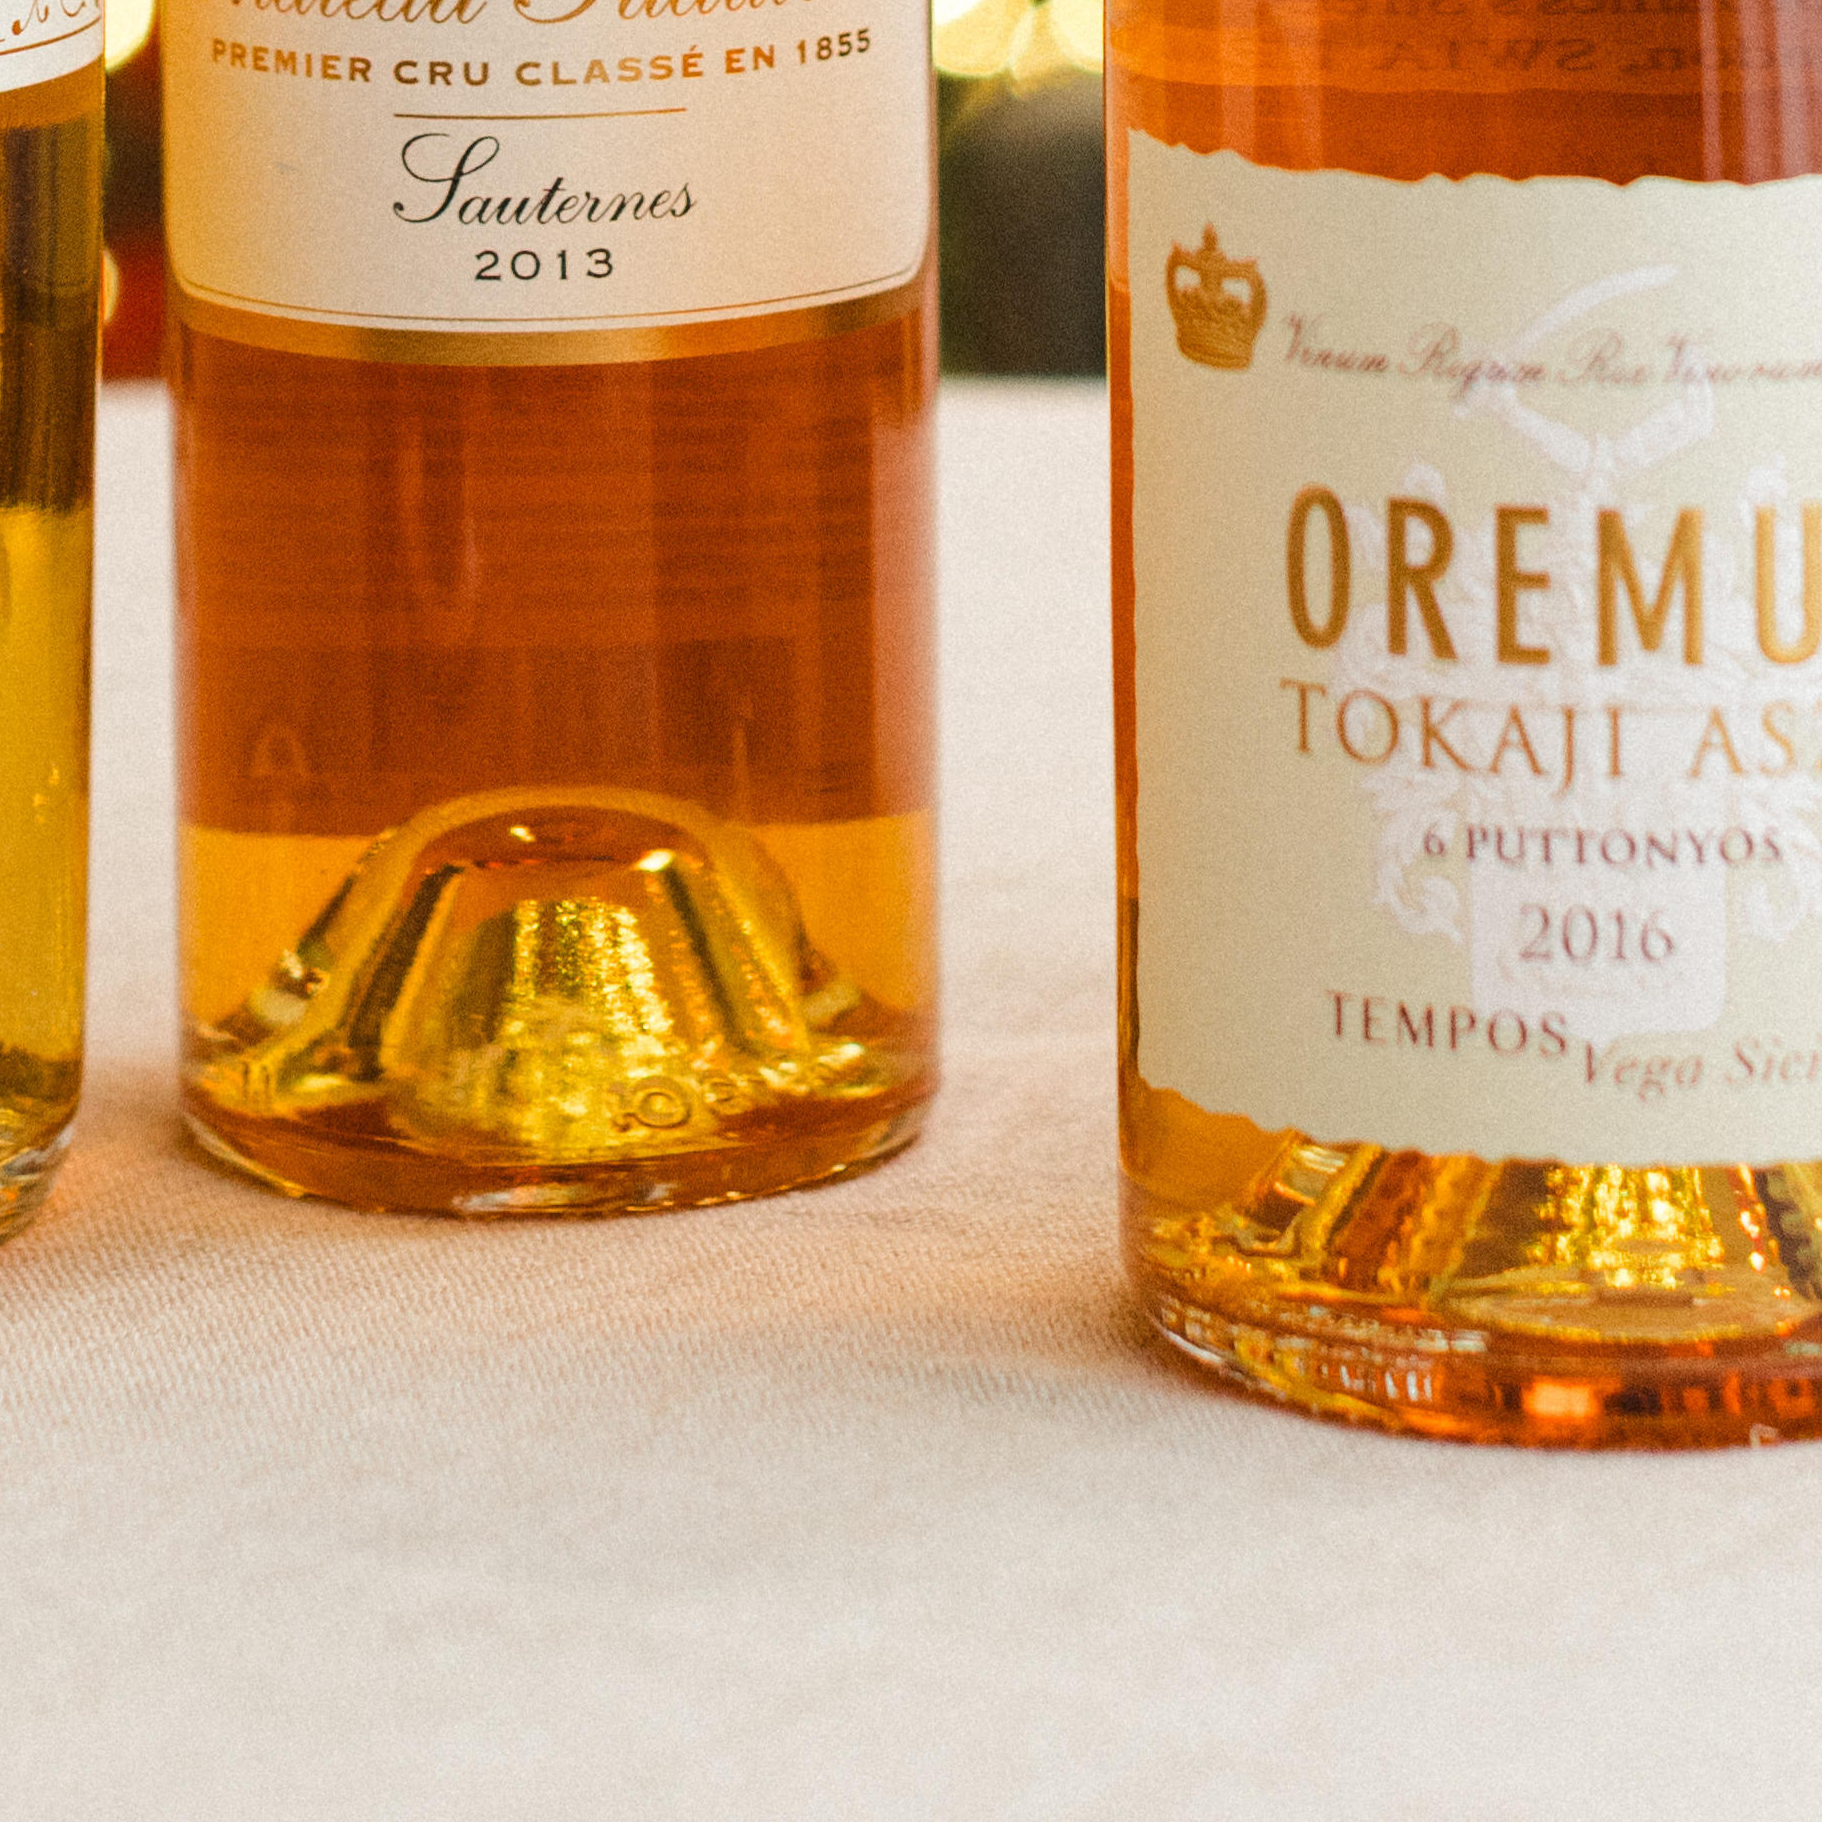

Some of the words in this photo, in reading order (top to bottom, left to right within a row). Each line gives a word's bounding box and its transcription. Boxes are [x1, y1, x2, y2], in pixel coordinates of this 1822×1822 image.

[210, 37, 372, 83] PREMIER
[392, 59, 491, 87] CRU
[514, 45, 705, 85] CLASSÉ
[723, 45, 777, 74] EN
[795, 27, 872, 65] 1855
[392, 132, 699, 226] Sauternes
[474, 248, 614, 282] 2013
[1277, 676, 1627, 799] TOKAJI
[1422, 821, 1447, 858] 6
[1465, 822, 1785, 869] PUTTONYOS
[1517, 901, 1677, 965] 2016
[1324, 987, 1572, 1060] TEMPOS
[1581, 1040, 1706, 1103] Vega
